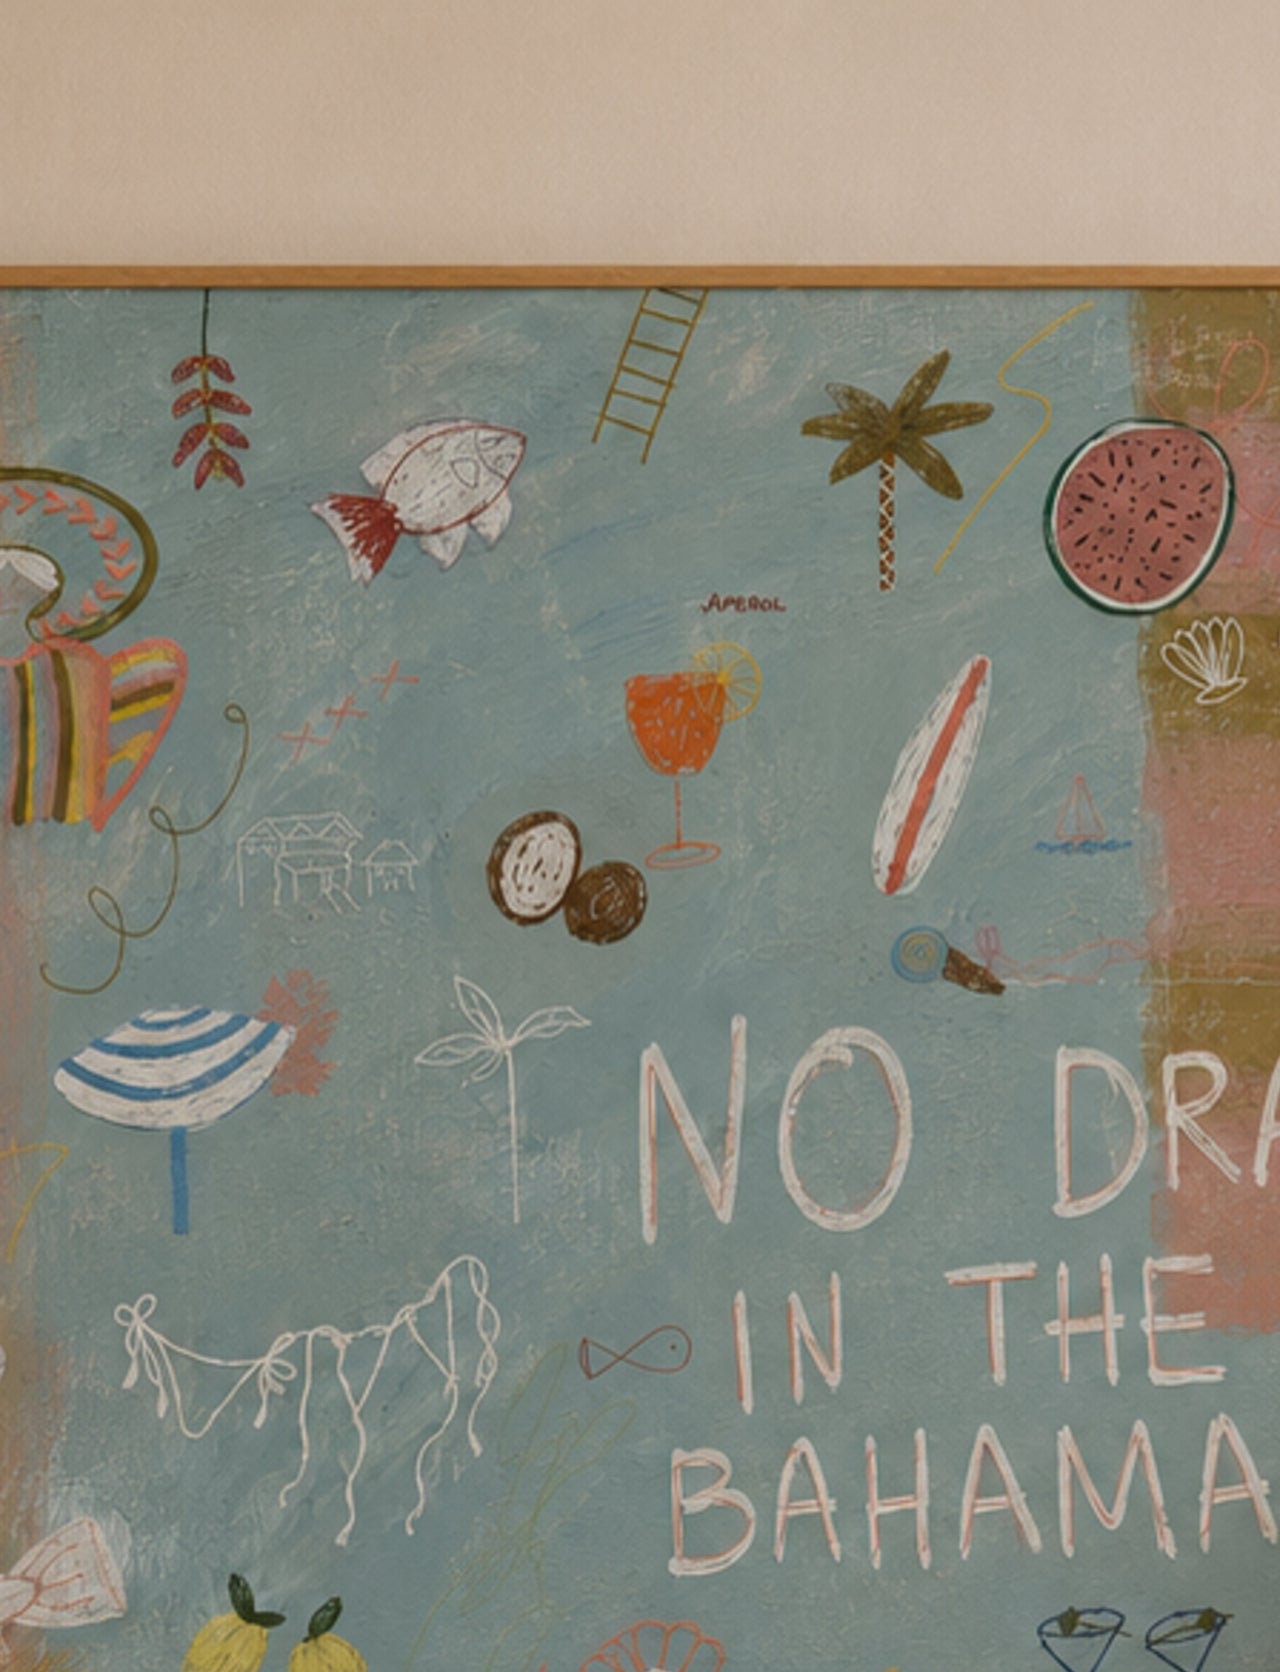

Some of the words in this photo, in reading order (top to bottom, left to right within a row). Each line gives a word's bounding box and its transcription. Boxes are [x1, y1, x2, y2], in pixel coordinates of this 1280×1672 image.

[700, 592, 787, 613] APEROL
[639, 1014, 912, 1245] NO
[732, 1271, 843, 1415] IN
[945, 1252, 1227, 1388] THE
